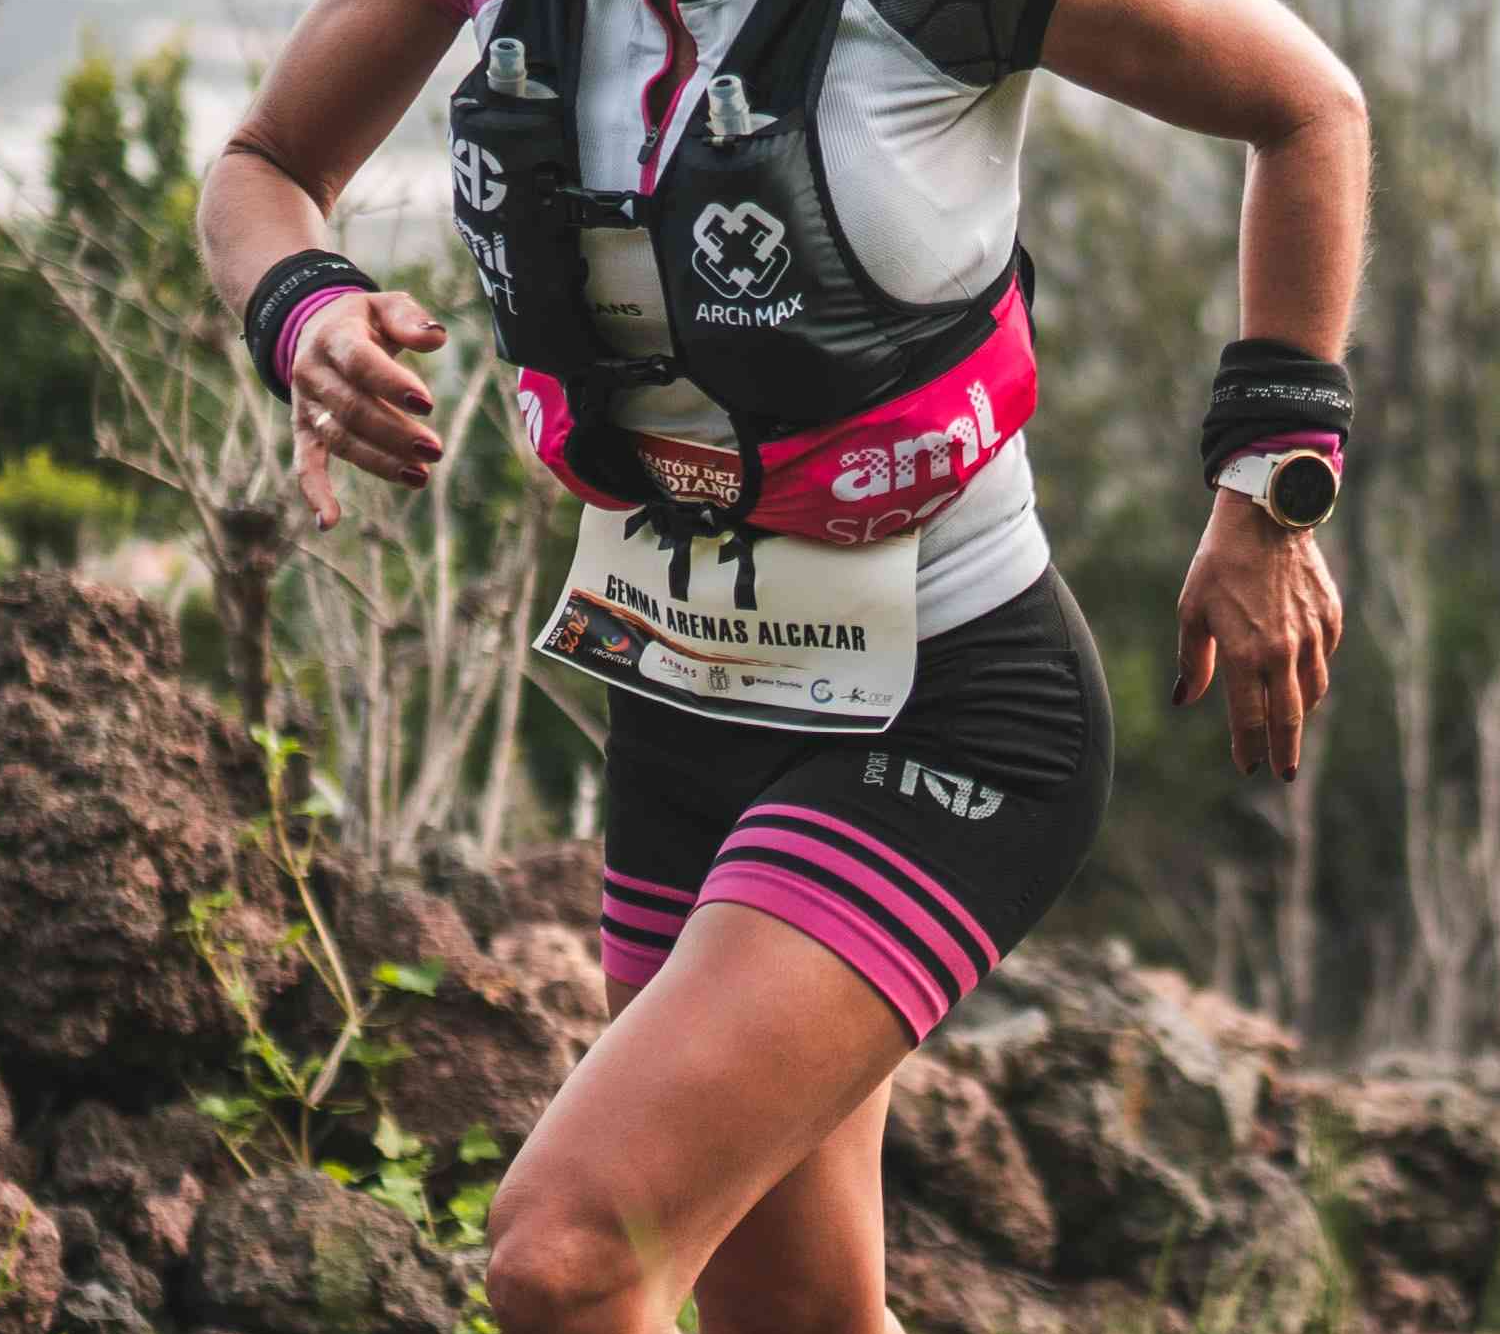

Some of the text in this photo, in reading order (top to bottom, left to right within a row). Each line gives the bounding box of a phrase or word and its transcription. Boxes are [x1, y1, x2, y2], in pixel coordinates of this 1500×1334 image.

[755, 293, 804, 327] MAX
[831, 380, 1001, 502] aml
[703, 467, 741, 487] DEL
[605, 574, 867, 652] GEMMA ARENAS ALCAZAR
[659, 655, 697, 678] ARMAS
[863, 751, 890, 787] SPORT
